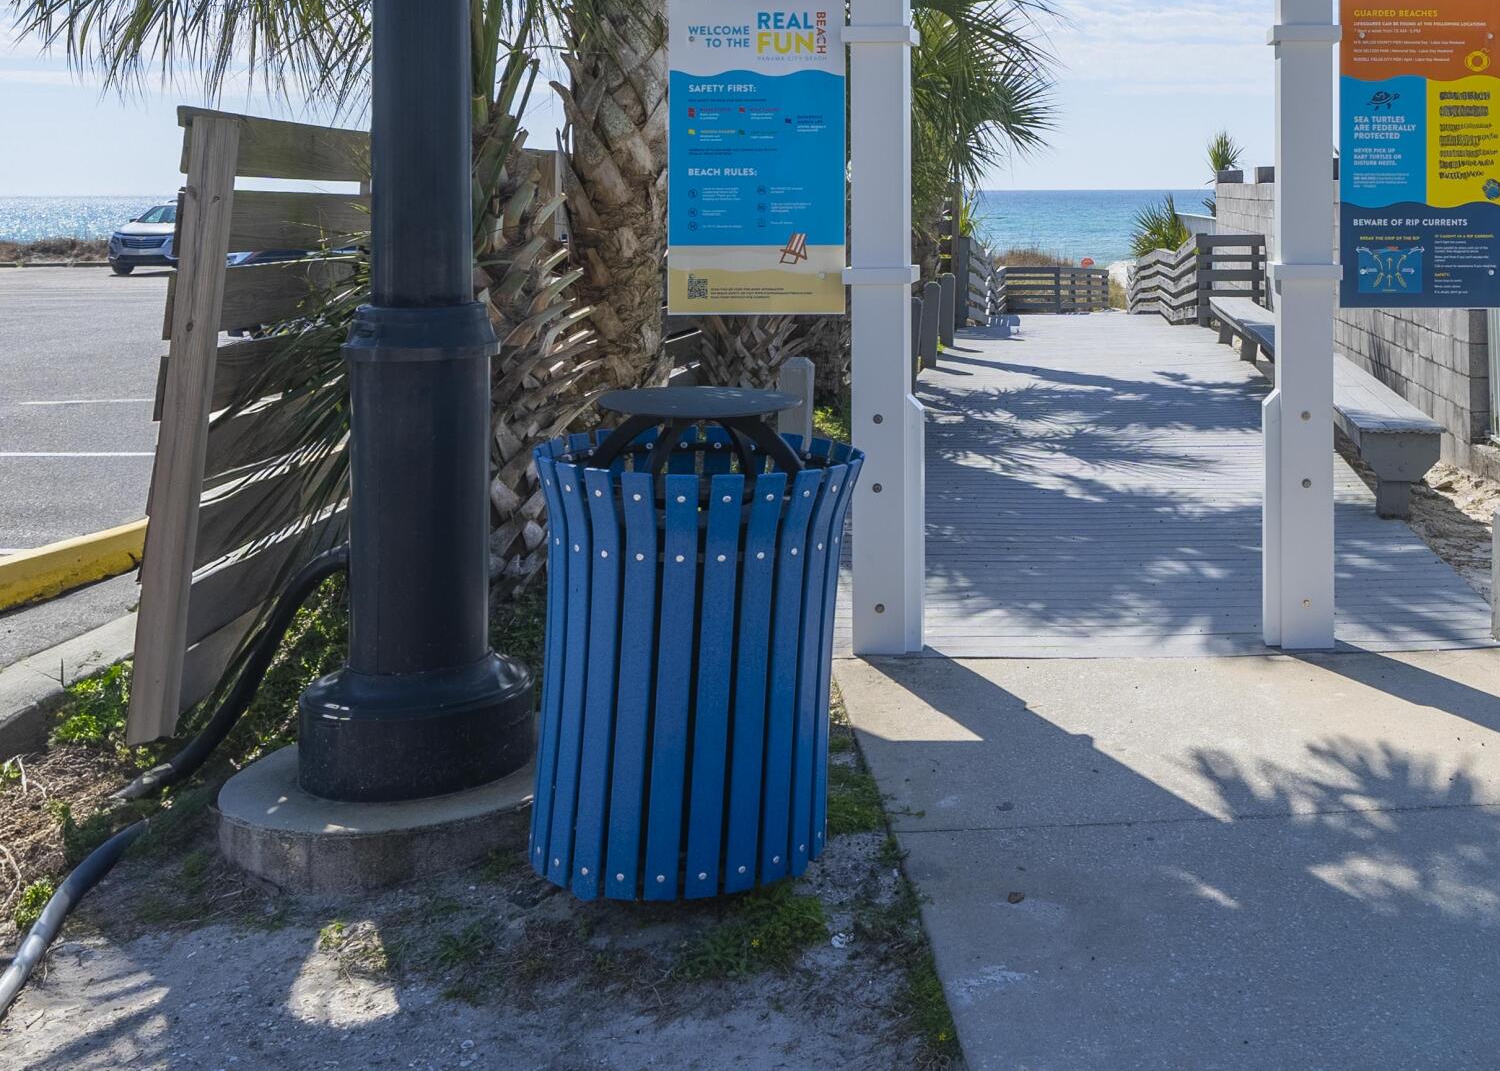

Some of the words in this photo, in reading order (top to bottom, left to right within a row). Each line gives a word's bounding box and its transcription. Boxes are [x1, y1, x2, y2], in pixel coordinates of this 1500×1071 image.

[1353, 9, 1396, 18] GUARDED
[1399, 9, 1439, 18] BEACHES
[757, 12, 814, 30] REAL
[688, 25, 750, 36] WELCOME
[816, 11, 827, 54] BEACH
[705, 38, 722, 48] TO
[726, 38, 750, 48] THE
[757, 32, 815, 54] FUN
[688, 84, 724, 93] SAFETY
[727, 84, 757, 93] FIRST:
[1353, 115, 1369, 123] SEA
[1371, 115, 1405, 123] TURTLES
[1353, 124, 1370, 132] ARE
[1372, 124, 1416, 132] FEDERALLY
[1353, 132, 1401, 140] PROTECTED
[687, 168, 721, 177] BEACH
[724, 168, 758, 177] RULES:
[1353, 218, 1388, 226] BEWARE
[1390, 218, 1404, 226] OF
[1405, 218, 1420, 226] RIP
[1422, 218, 1468, 226] CURRENTS
